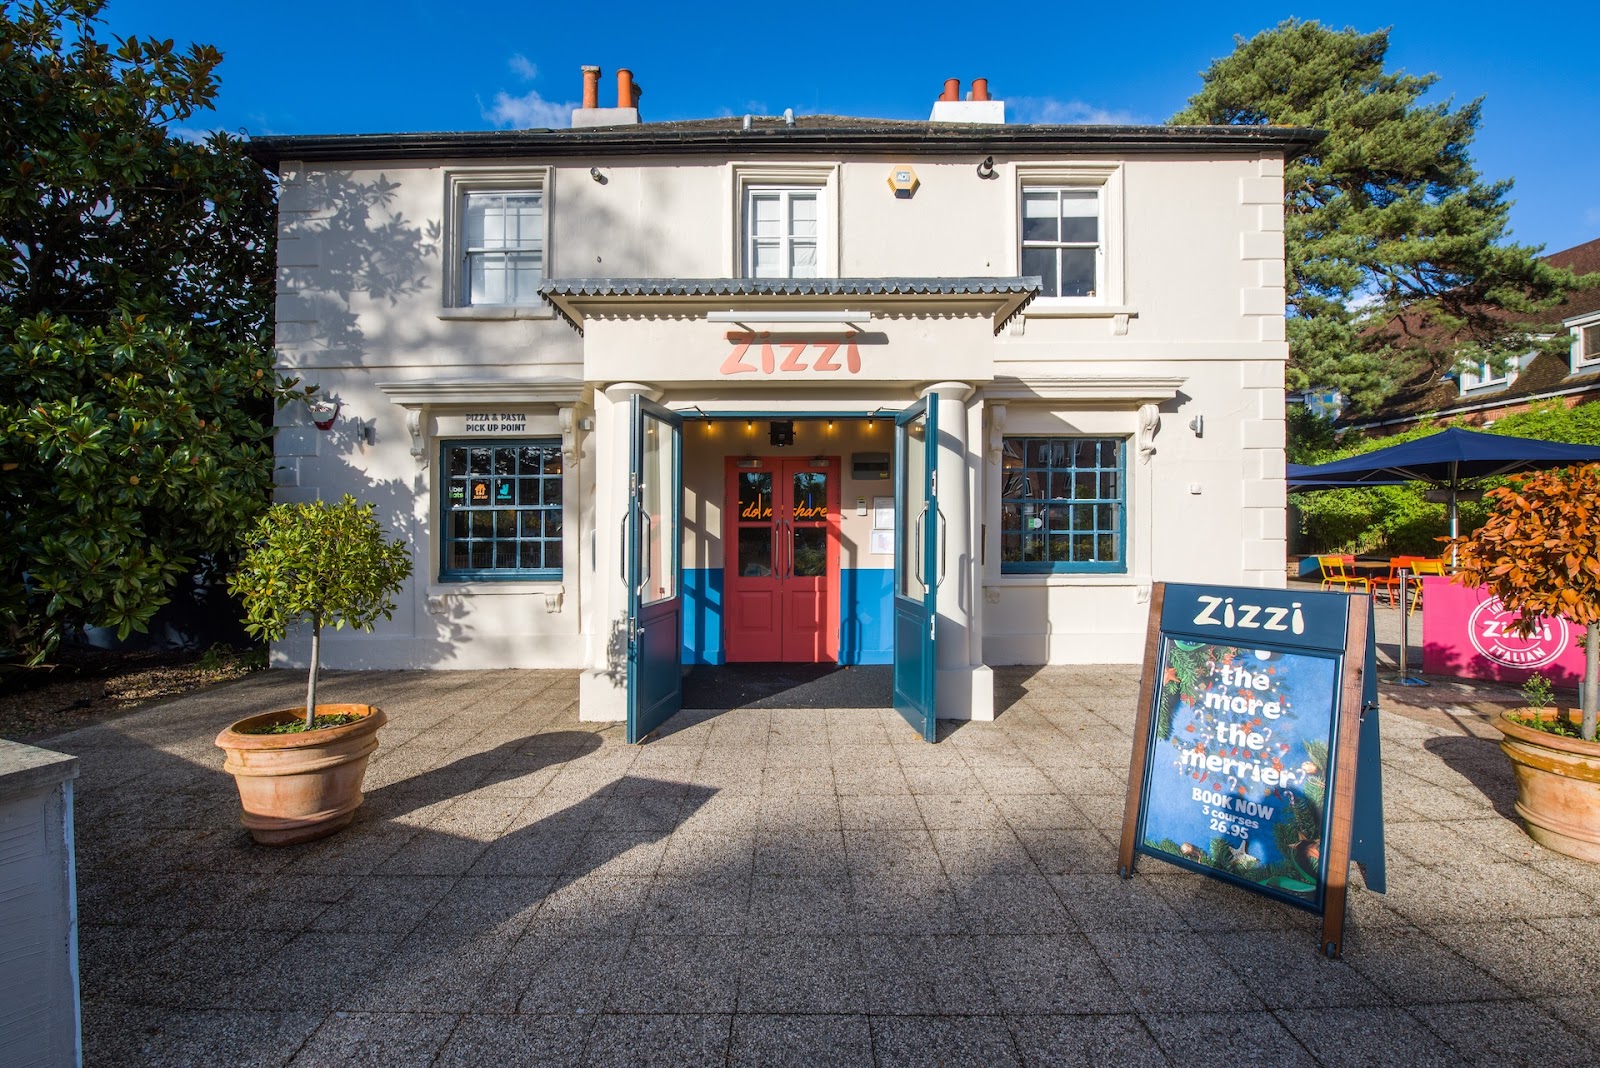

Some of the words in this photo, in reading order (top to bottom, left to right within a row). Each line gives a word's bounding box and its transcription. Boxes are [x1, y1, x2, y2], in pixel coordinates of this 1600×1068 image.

[466, 413, 490, 422] PIZZA
[491, 413, 499, 422] &
[501, 413, 526, 422] PASTA
[466, 424, 486, 432] PICK
[487, 424, 499, 432] UP
[501, 424, 526, 432] POINT
[1193, 595, 1305, 635] Zizzi
[1489, 645, 1546, 662] ITALIAN
[1221, 664, 1270, 691] the
[1204, 692, 1281, 719] more
[1215, 721, 1264, 750] the
[1181, 748, 1296, 788] merrier
[1192, 787, 1233, 810] BOOK
[1235, 799, 1274, 820] NOW
[1202, 805, 1210, 815] 3
[1211, 809, 1259, 829] courses
[1209, 818, 1249, 839] 26.95
